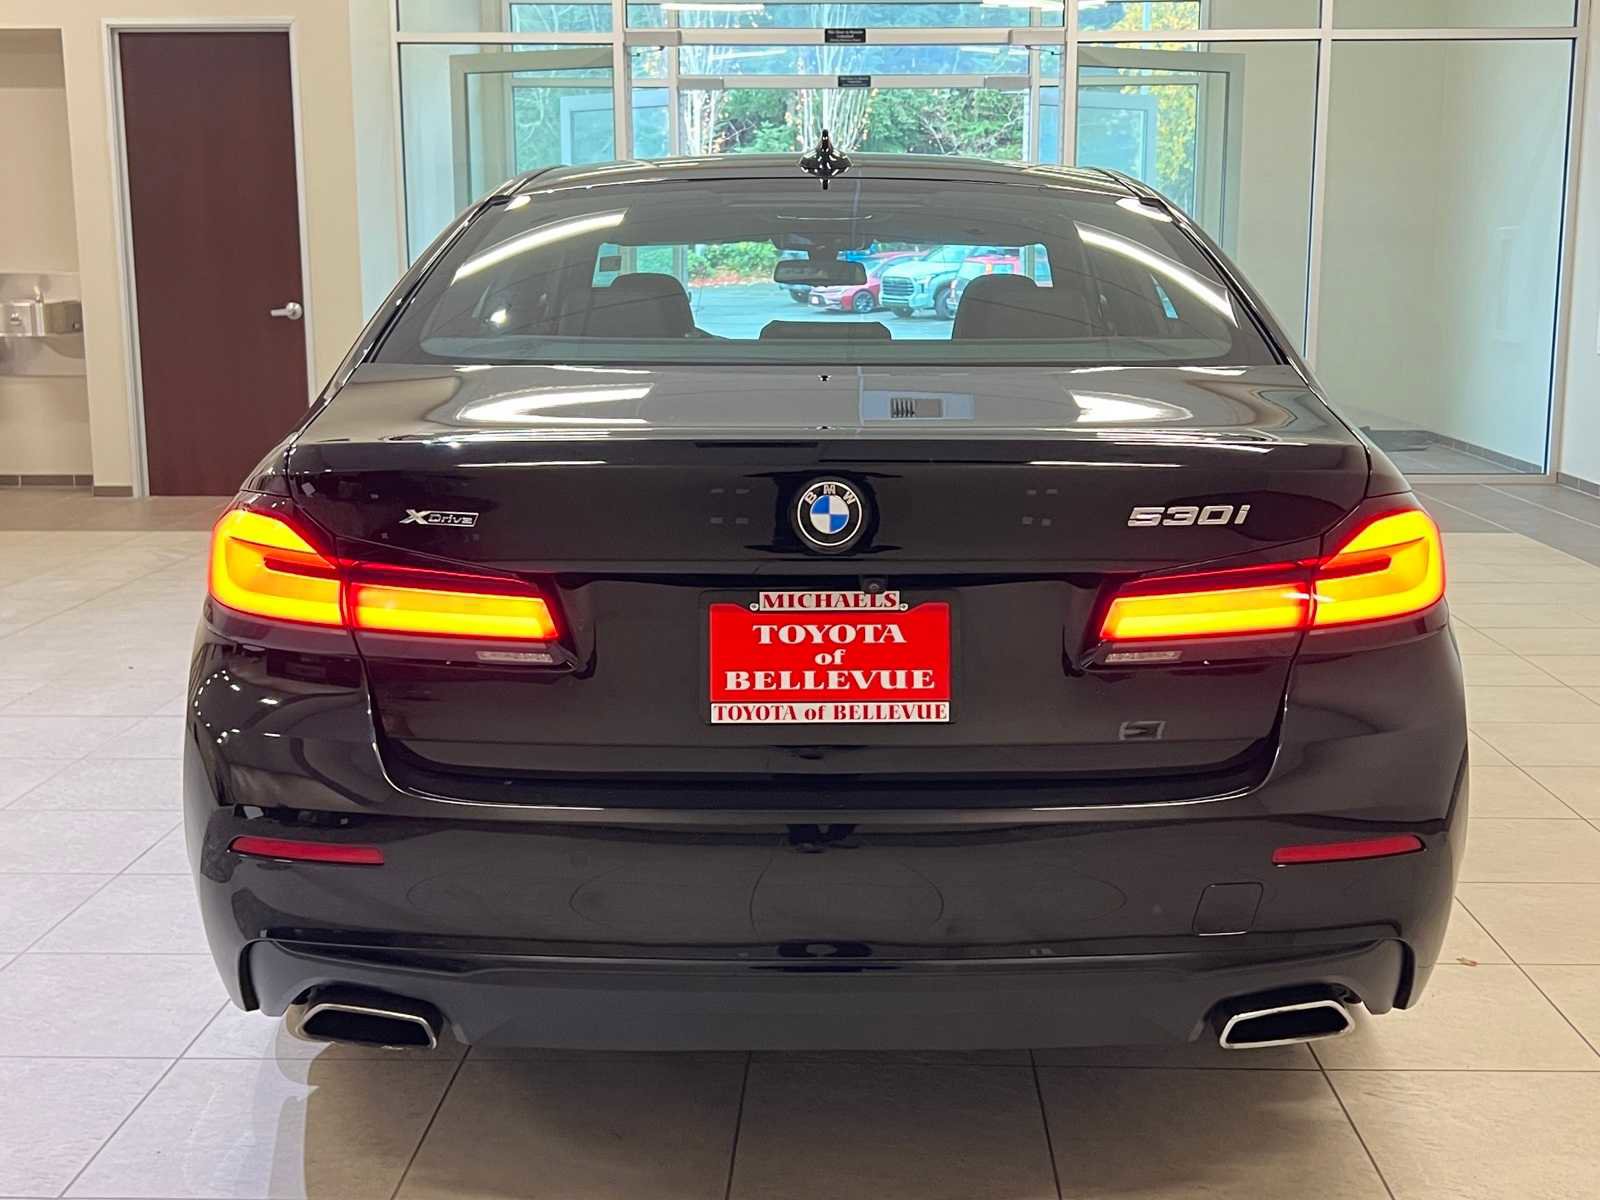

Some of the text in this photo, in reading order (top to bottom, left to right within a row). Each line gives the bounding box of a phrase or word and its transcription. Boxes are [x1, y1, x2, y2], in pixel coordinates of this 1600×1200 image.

[804, 484, 857, 505] BMW
[1127, 504, 1251, 527] 530i
[762, 592, 898, 609] MICHAELS
[752, 624, 907, 645] TOYOTA
[814, 648, 847, 666] of
[724, 669, 935, 691] BELLEVUE
[713, 703, 948, 721] TOYOTA of BELLEVUE
